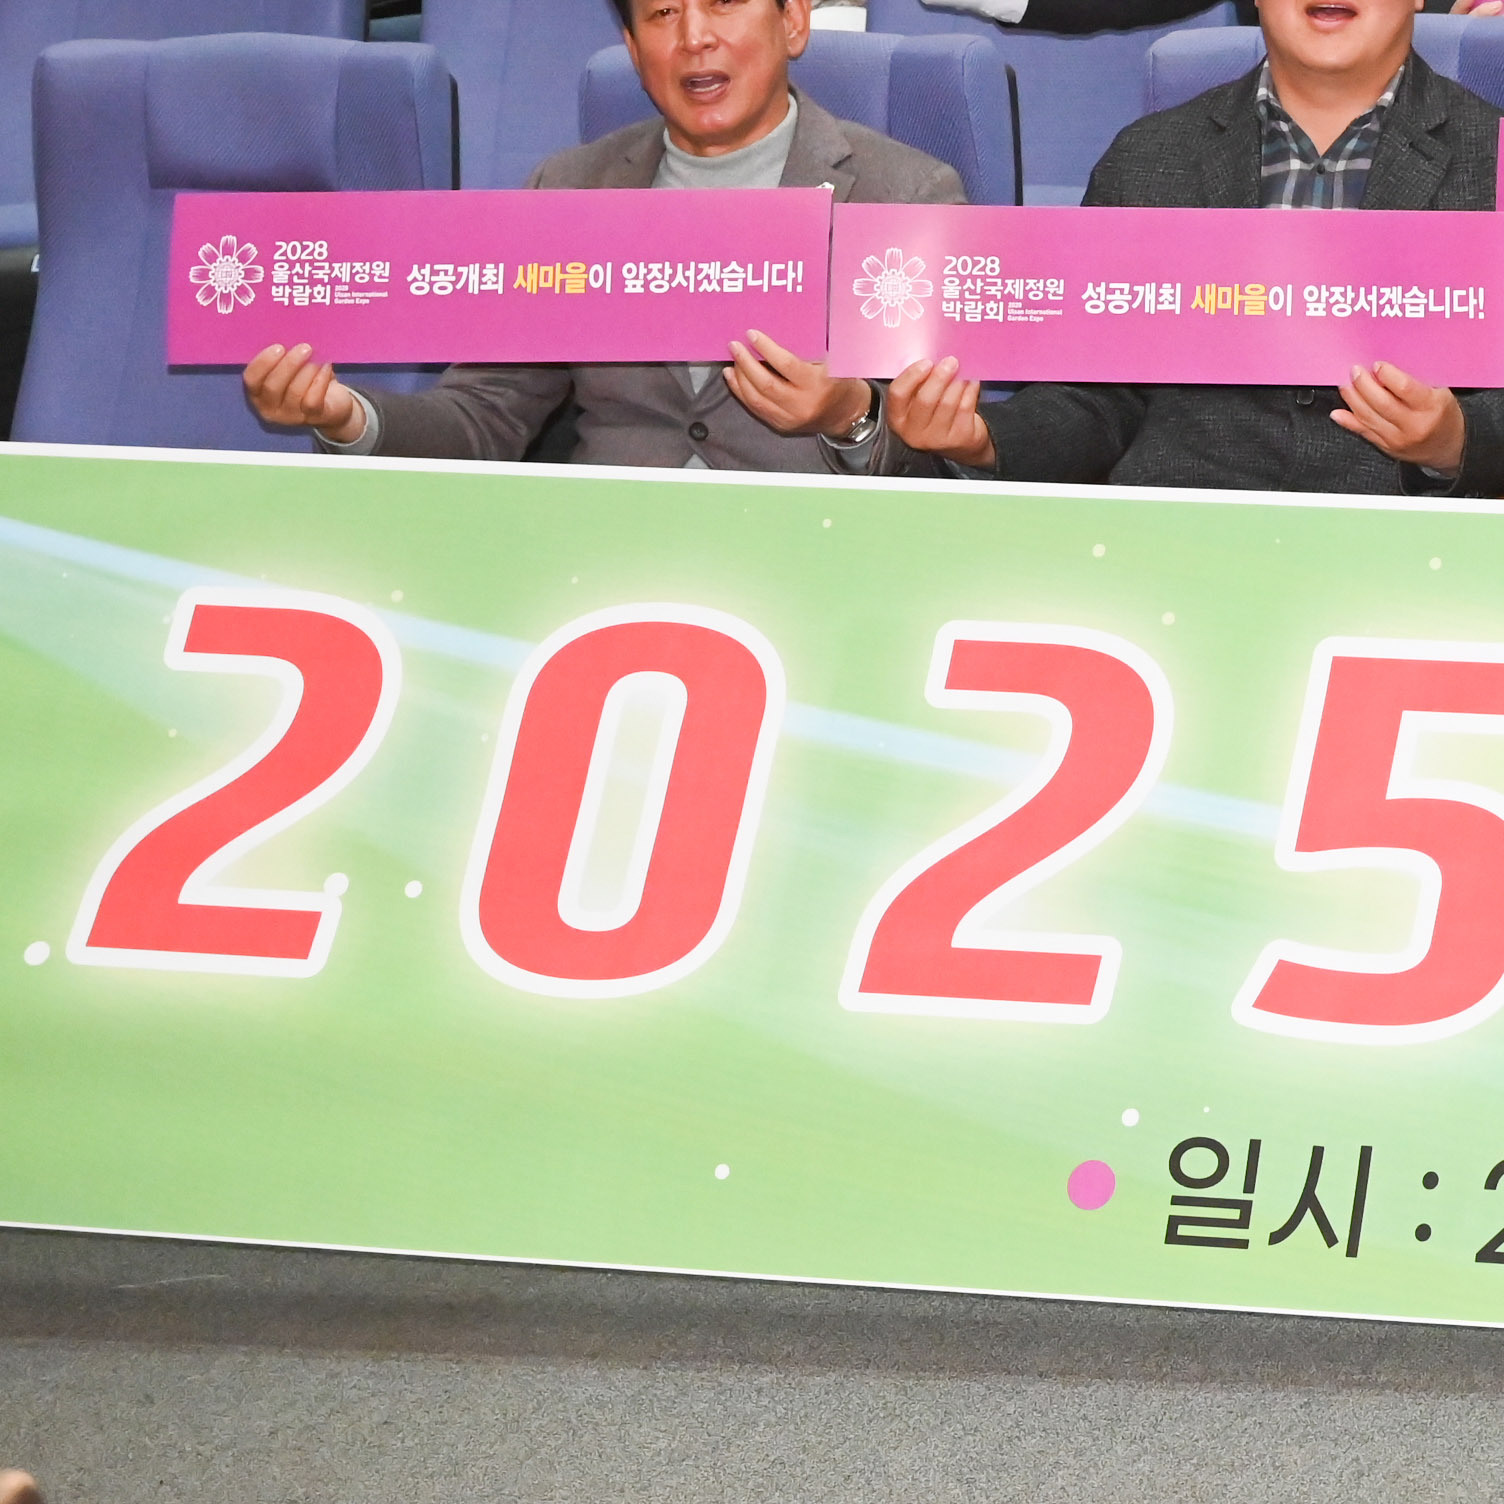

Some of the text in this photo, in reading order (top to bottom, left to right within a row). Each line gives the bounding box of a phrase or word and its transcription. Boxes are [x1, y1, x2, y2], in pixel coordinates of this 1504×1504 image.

[274, 240, 328, 260] 2028
[272, 261, 390, 284] 울산국제정원
[944, 255, 1000, 276] 2028
[406, 260, 803, 296] 성공개최 새마을이 앞장서겠습니다!
[943, 276, 1064, 301] 울산국제정원
[272, 284, 330, 306] 박람회
[1081, 282, 1485, 319] 성공개최 새마을이 앞장서겠습니다!
[943, 300, 1003, 322] 박람회
[1165, 1137, 1373, 1258] 일시
